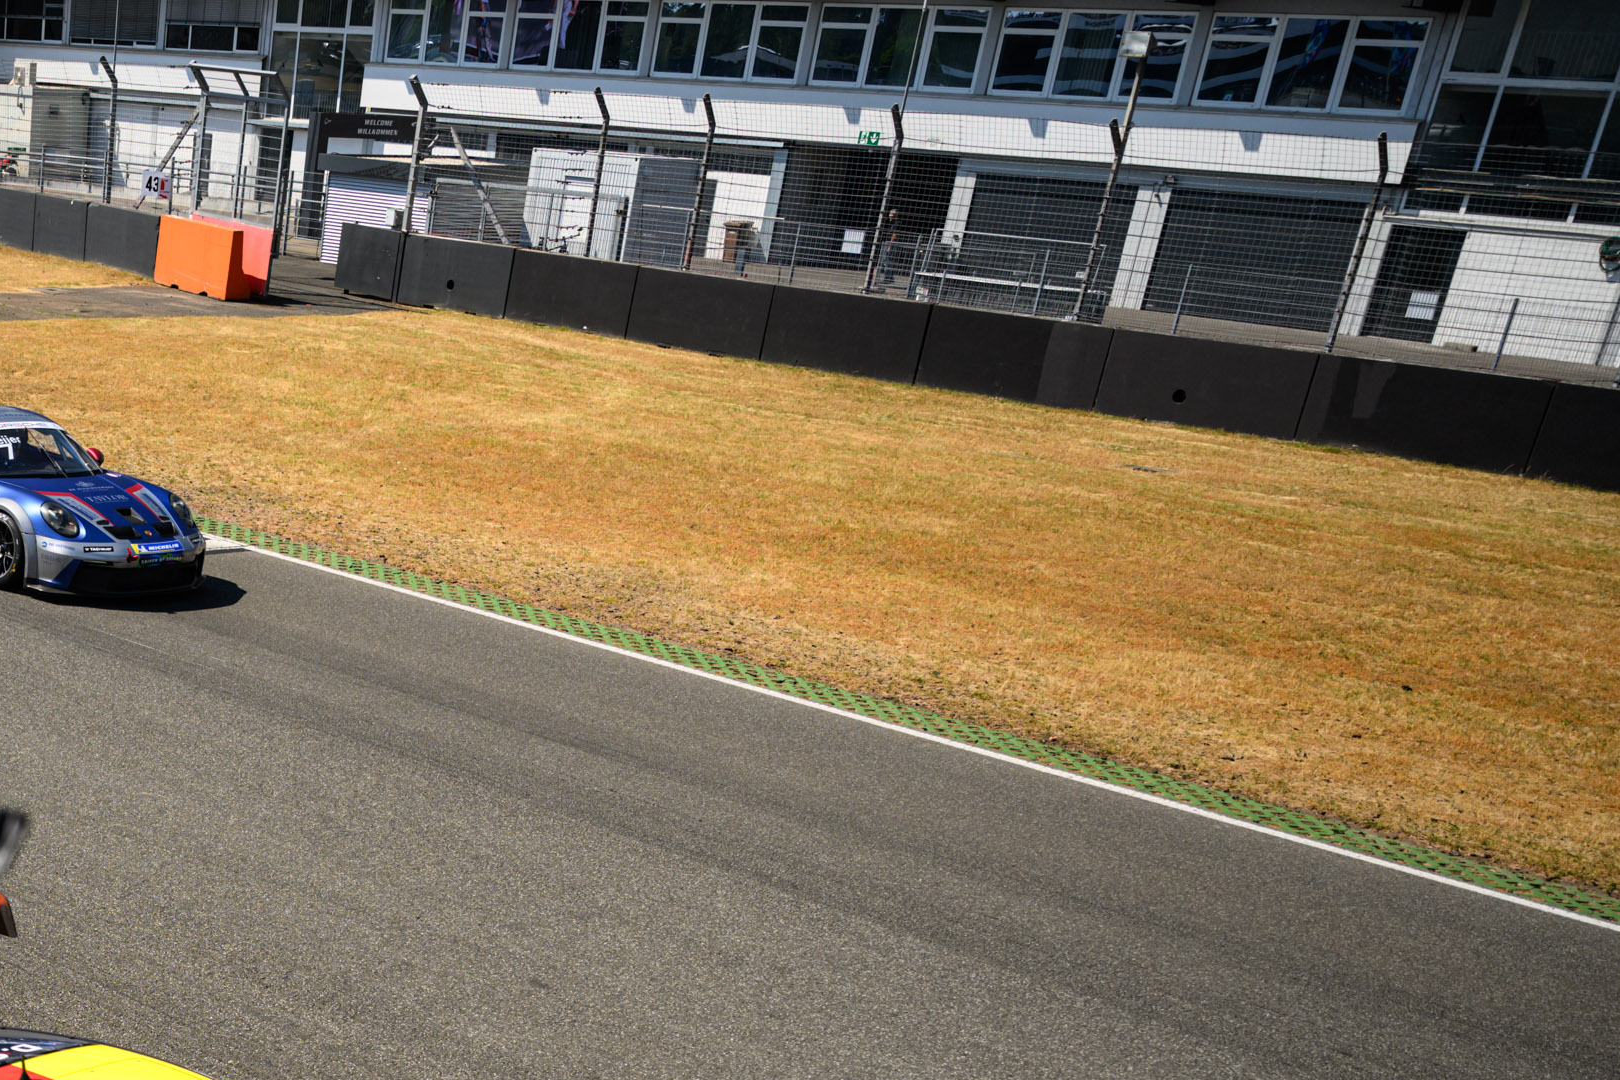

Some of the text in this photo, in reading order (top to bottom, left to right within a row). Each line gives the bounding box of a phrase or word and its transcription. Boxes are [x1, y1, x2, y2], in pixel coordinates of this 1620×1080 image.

[364, 119, 394, 127] WELCOME
[357, 128, 398, 136] WILLKOMMEN
[145, 175, 159, 192] 43
[148, 543, 180, 551] MICHELIN
